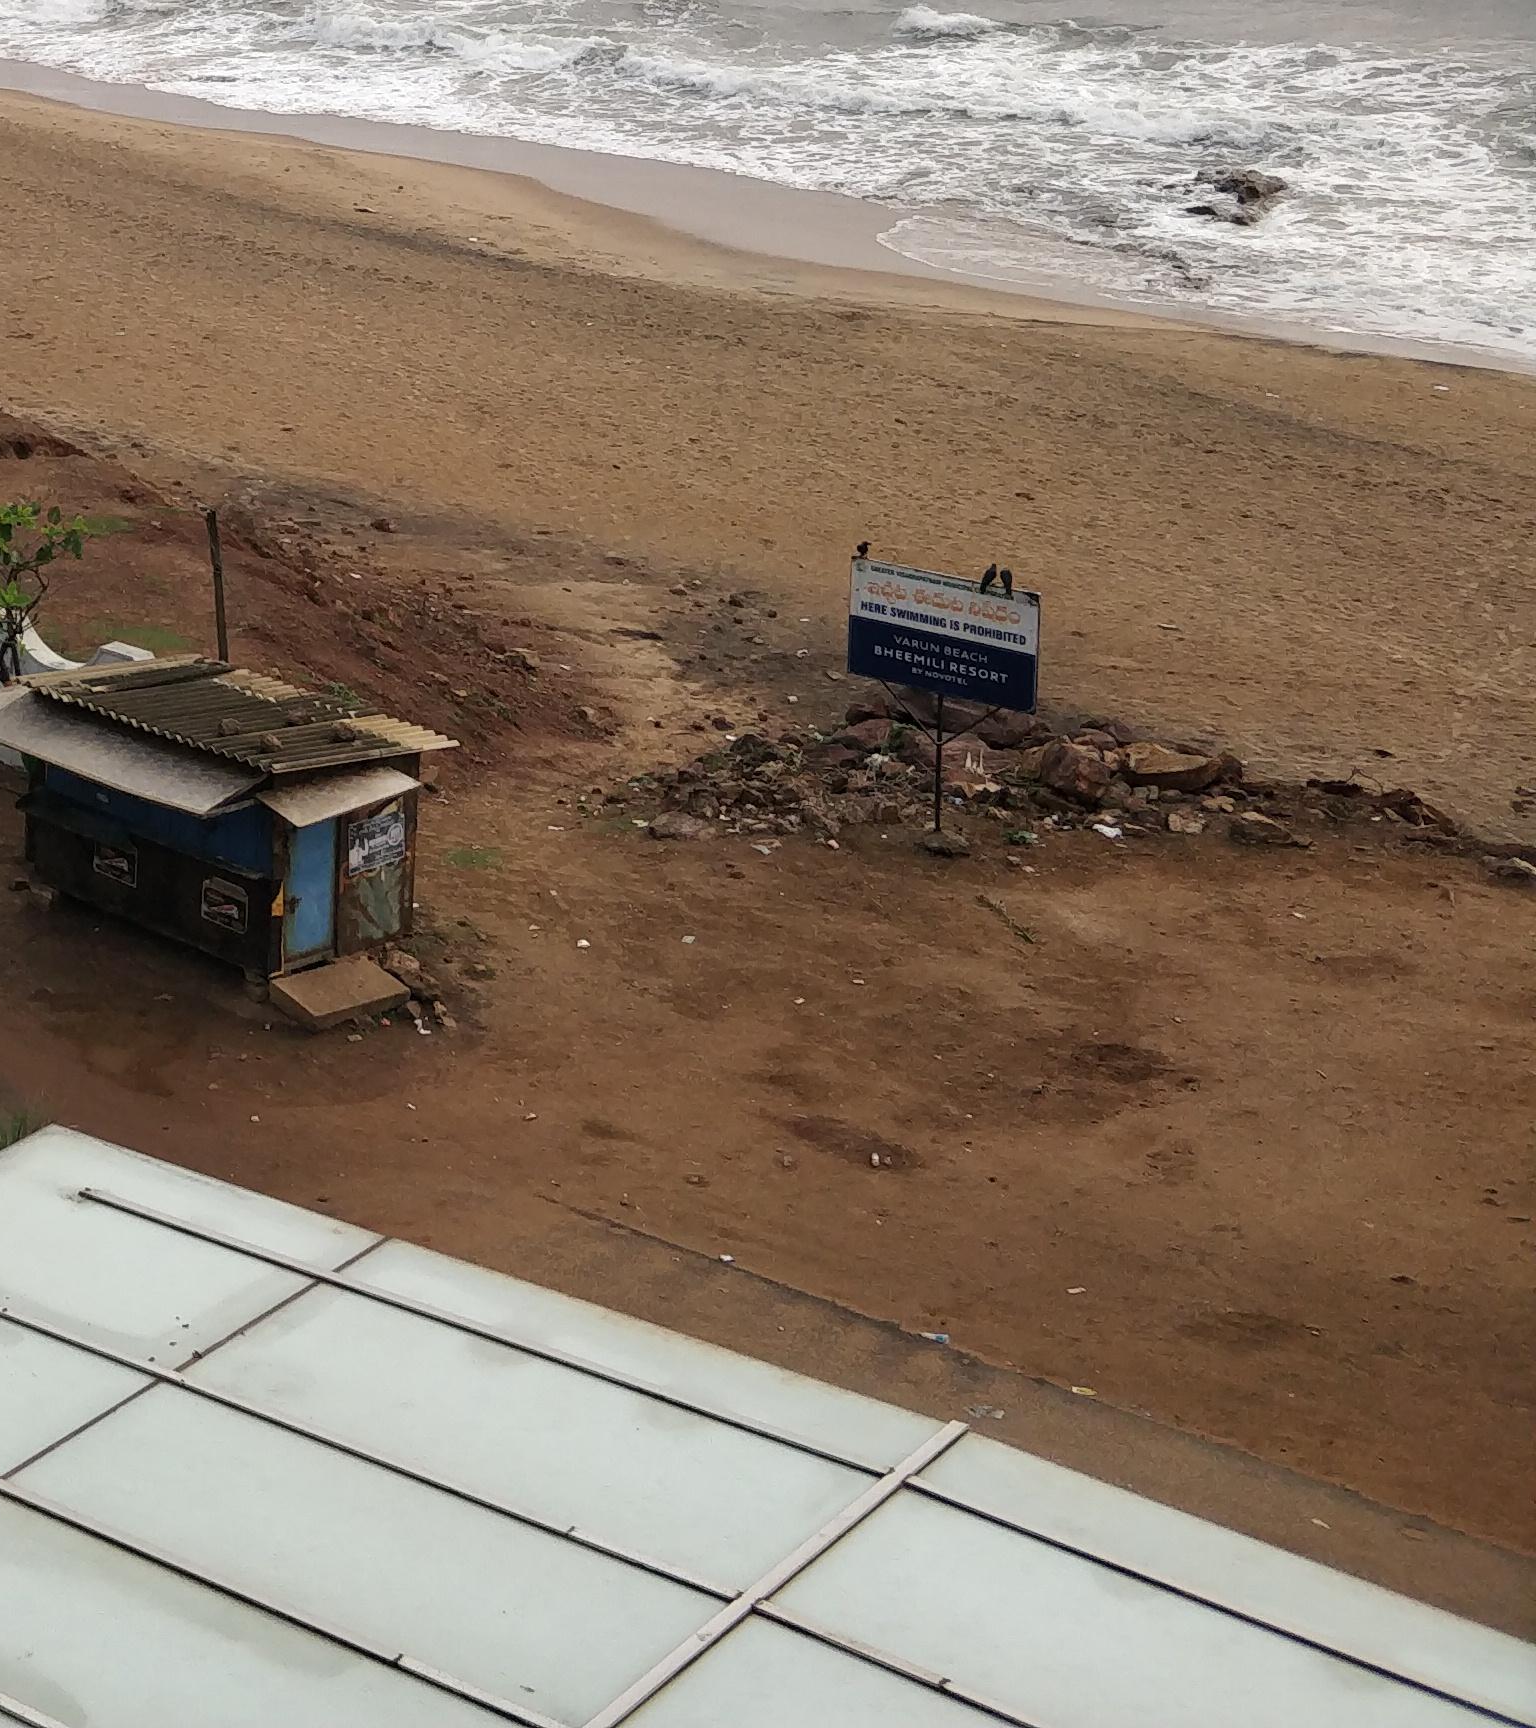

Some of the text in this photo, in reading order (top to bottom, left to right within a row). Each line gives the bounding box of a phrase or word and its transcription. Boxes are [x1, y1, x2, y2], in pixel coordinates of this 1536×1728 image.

[860, 600, 1027, 646] HERE SWIMMING IS PROHIBITED
[873, 645, 1009, 685] BHEEMILI RESORT
[893, 634, 988, 664] VARUN BEACH
[911, 666, 968, 686] BY NOVOTEL
